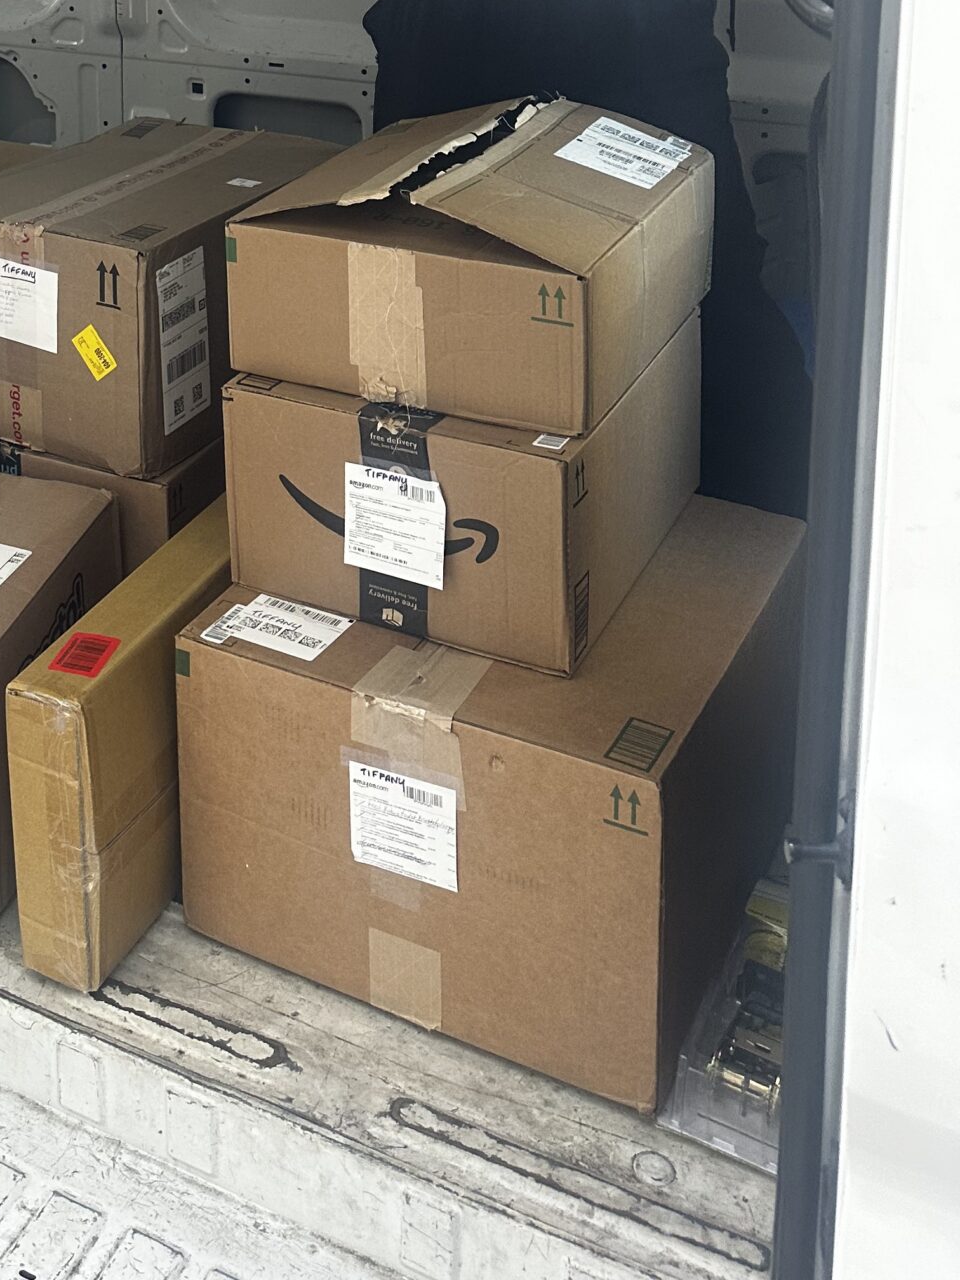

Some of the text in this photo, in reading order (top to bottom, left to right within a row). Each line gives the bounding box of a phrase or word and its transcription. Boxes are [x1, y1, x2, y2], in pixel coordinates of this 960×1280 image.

[370, 432, 418, 450] free delivery
[349, 479, 384, 491] amazon.com
[368, 588, 418, 611] free delivery
